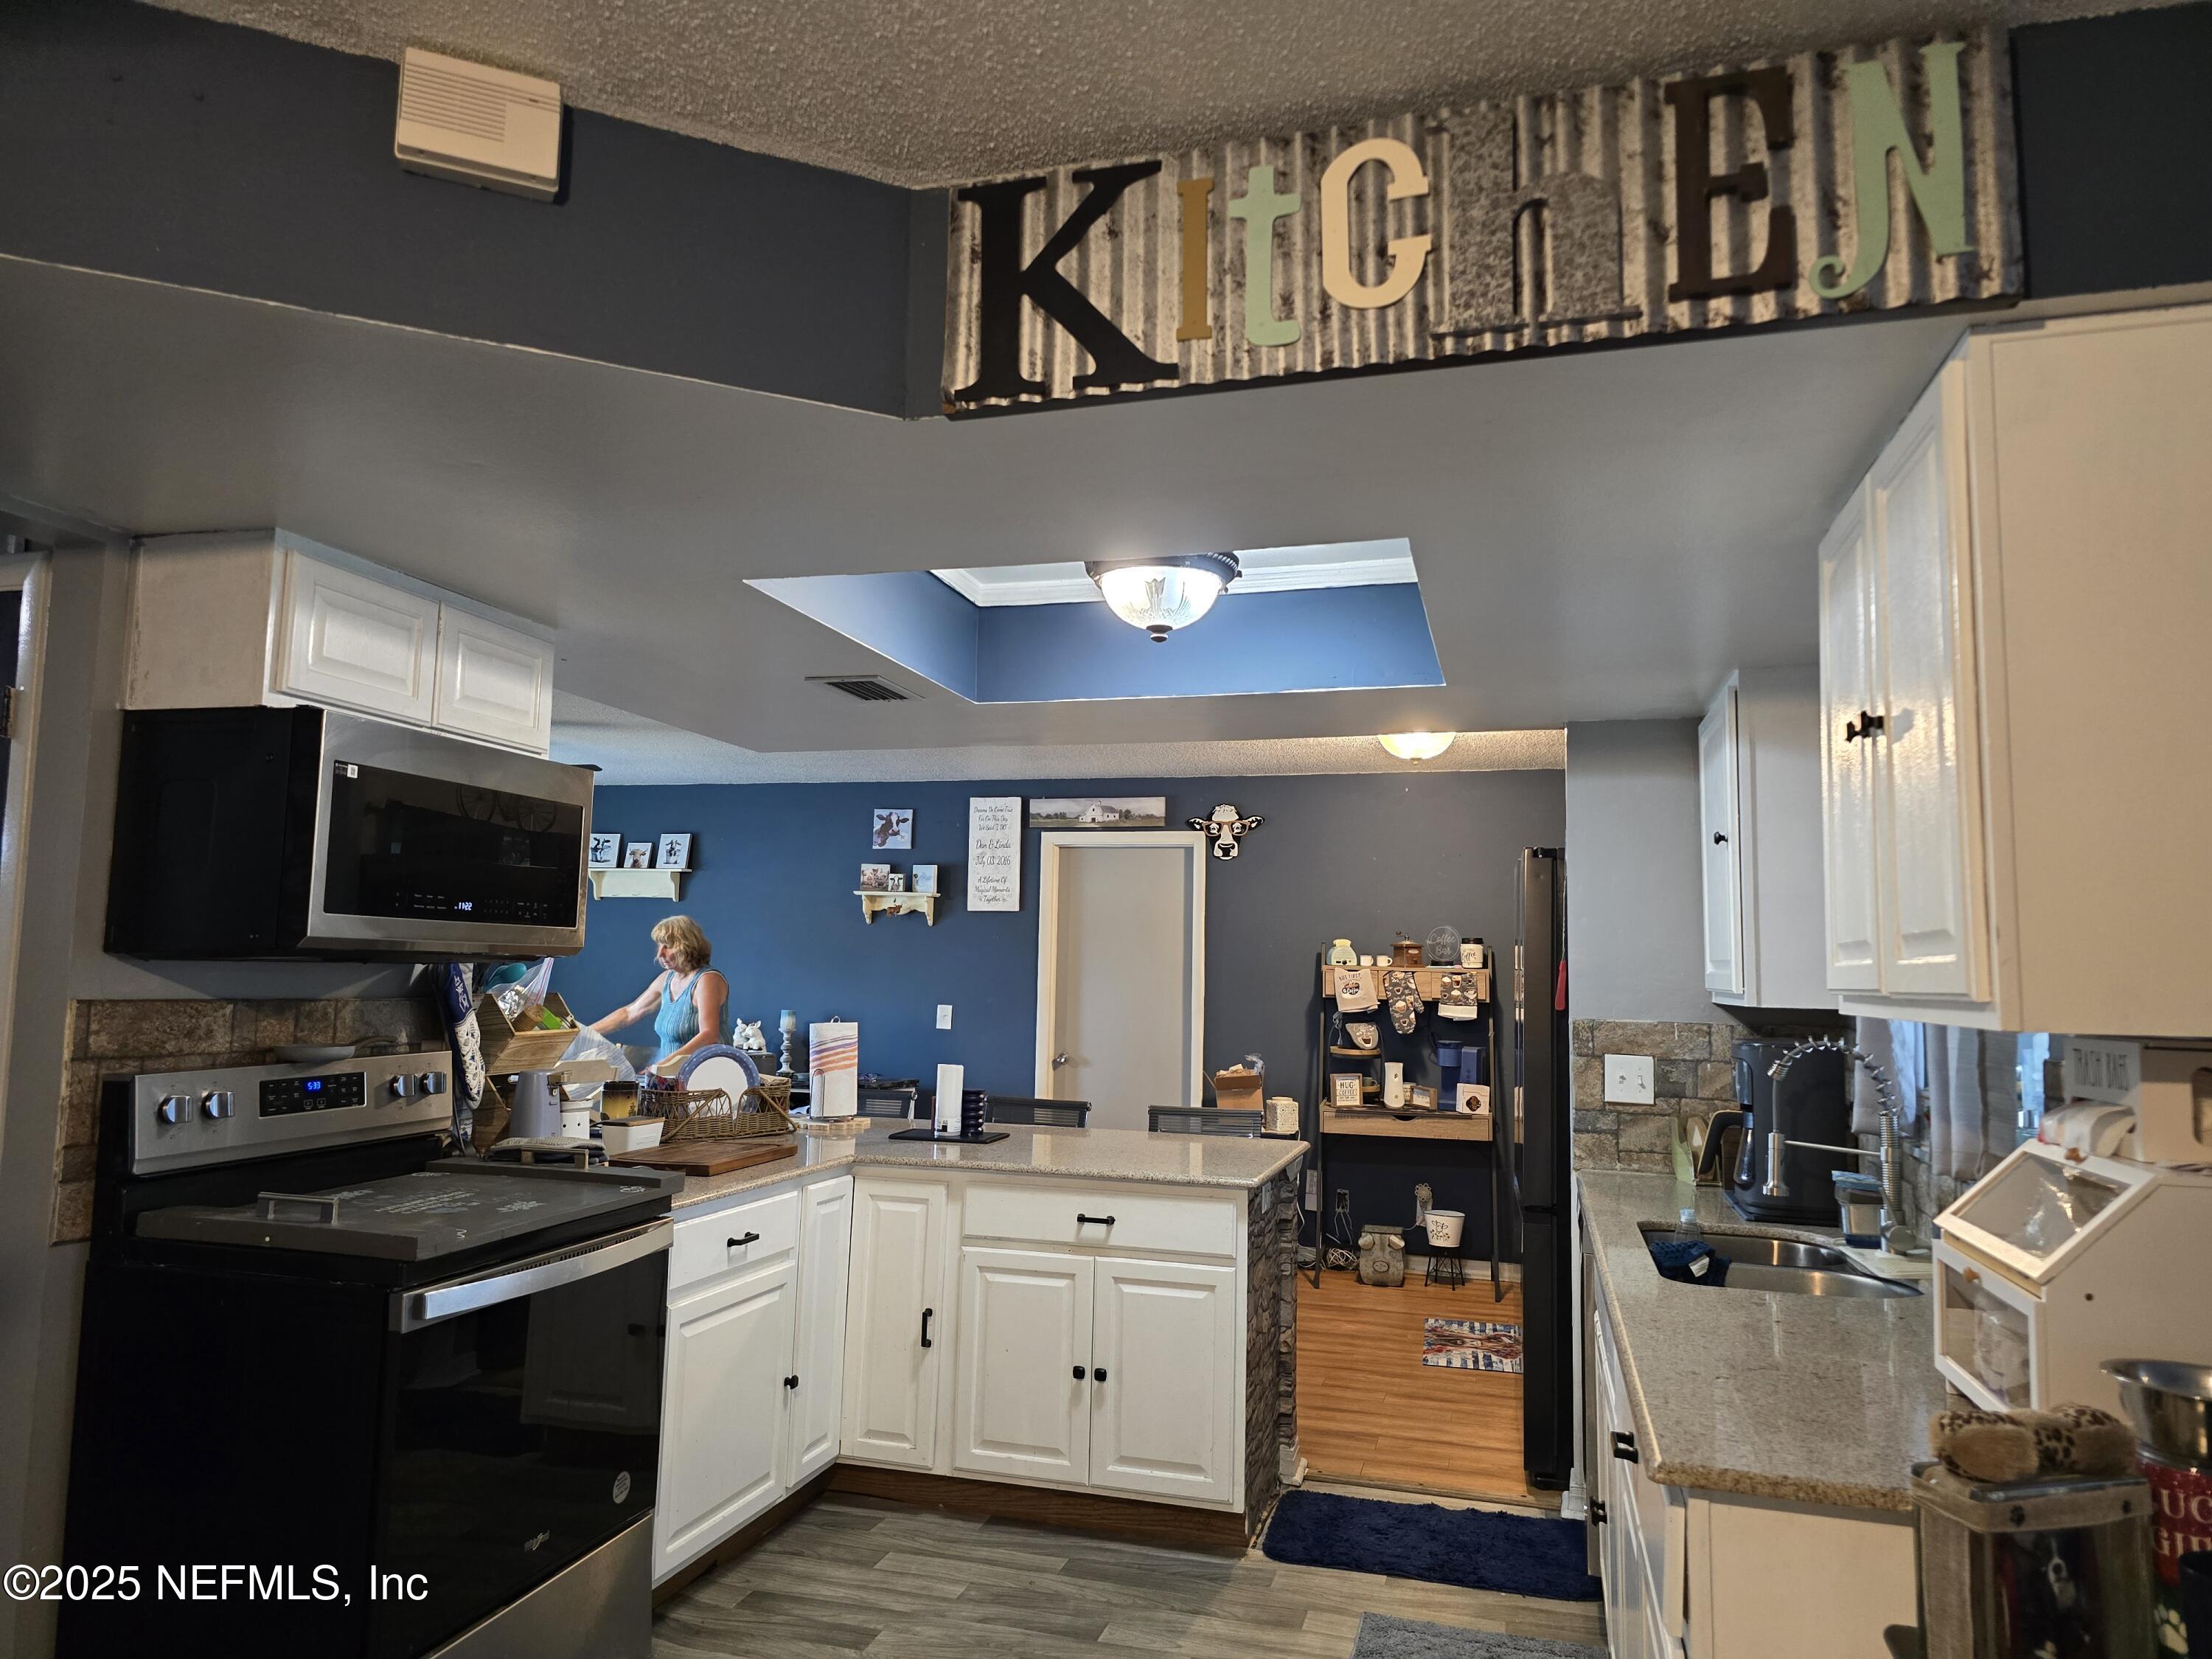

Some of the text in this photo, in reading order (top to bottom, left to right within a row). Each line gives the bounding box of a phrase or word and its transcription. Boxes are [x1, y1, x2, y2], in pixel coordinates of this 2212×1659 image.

[988, 838, 995, 849] &
[995, 838, 1011, 849] Linda
[975, 855, 986, 868] July
[996, 855, 1011, 866] 2016
[982, 875, 1000, 885] Lifetime
[974, 886, 991, 894] Magical
[1427, 933, 1456, 945] Coffee
[1435, 945, 1452, 956] Bar
[1340, 1081, 1354, 1089] HUG
